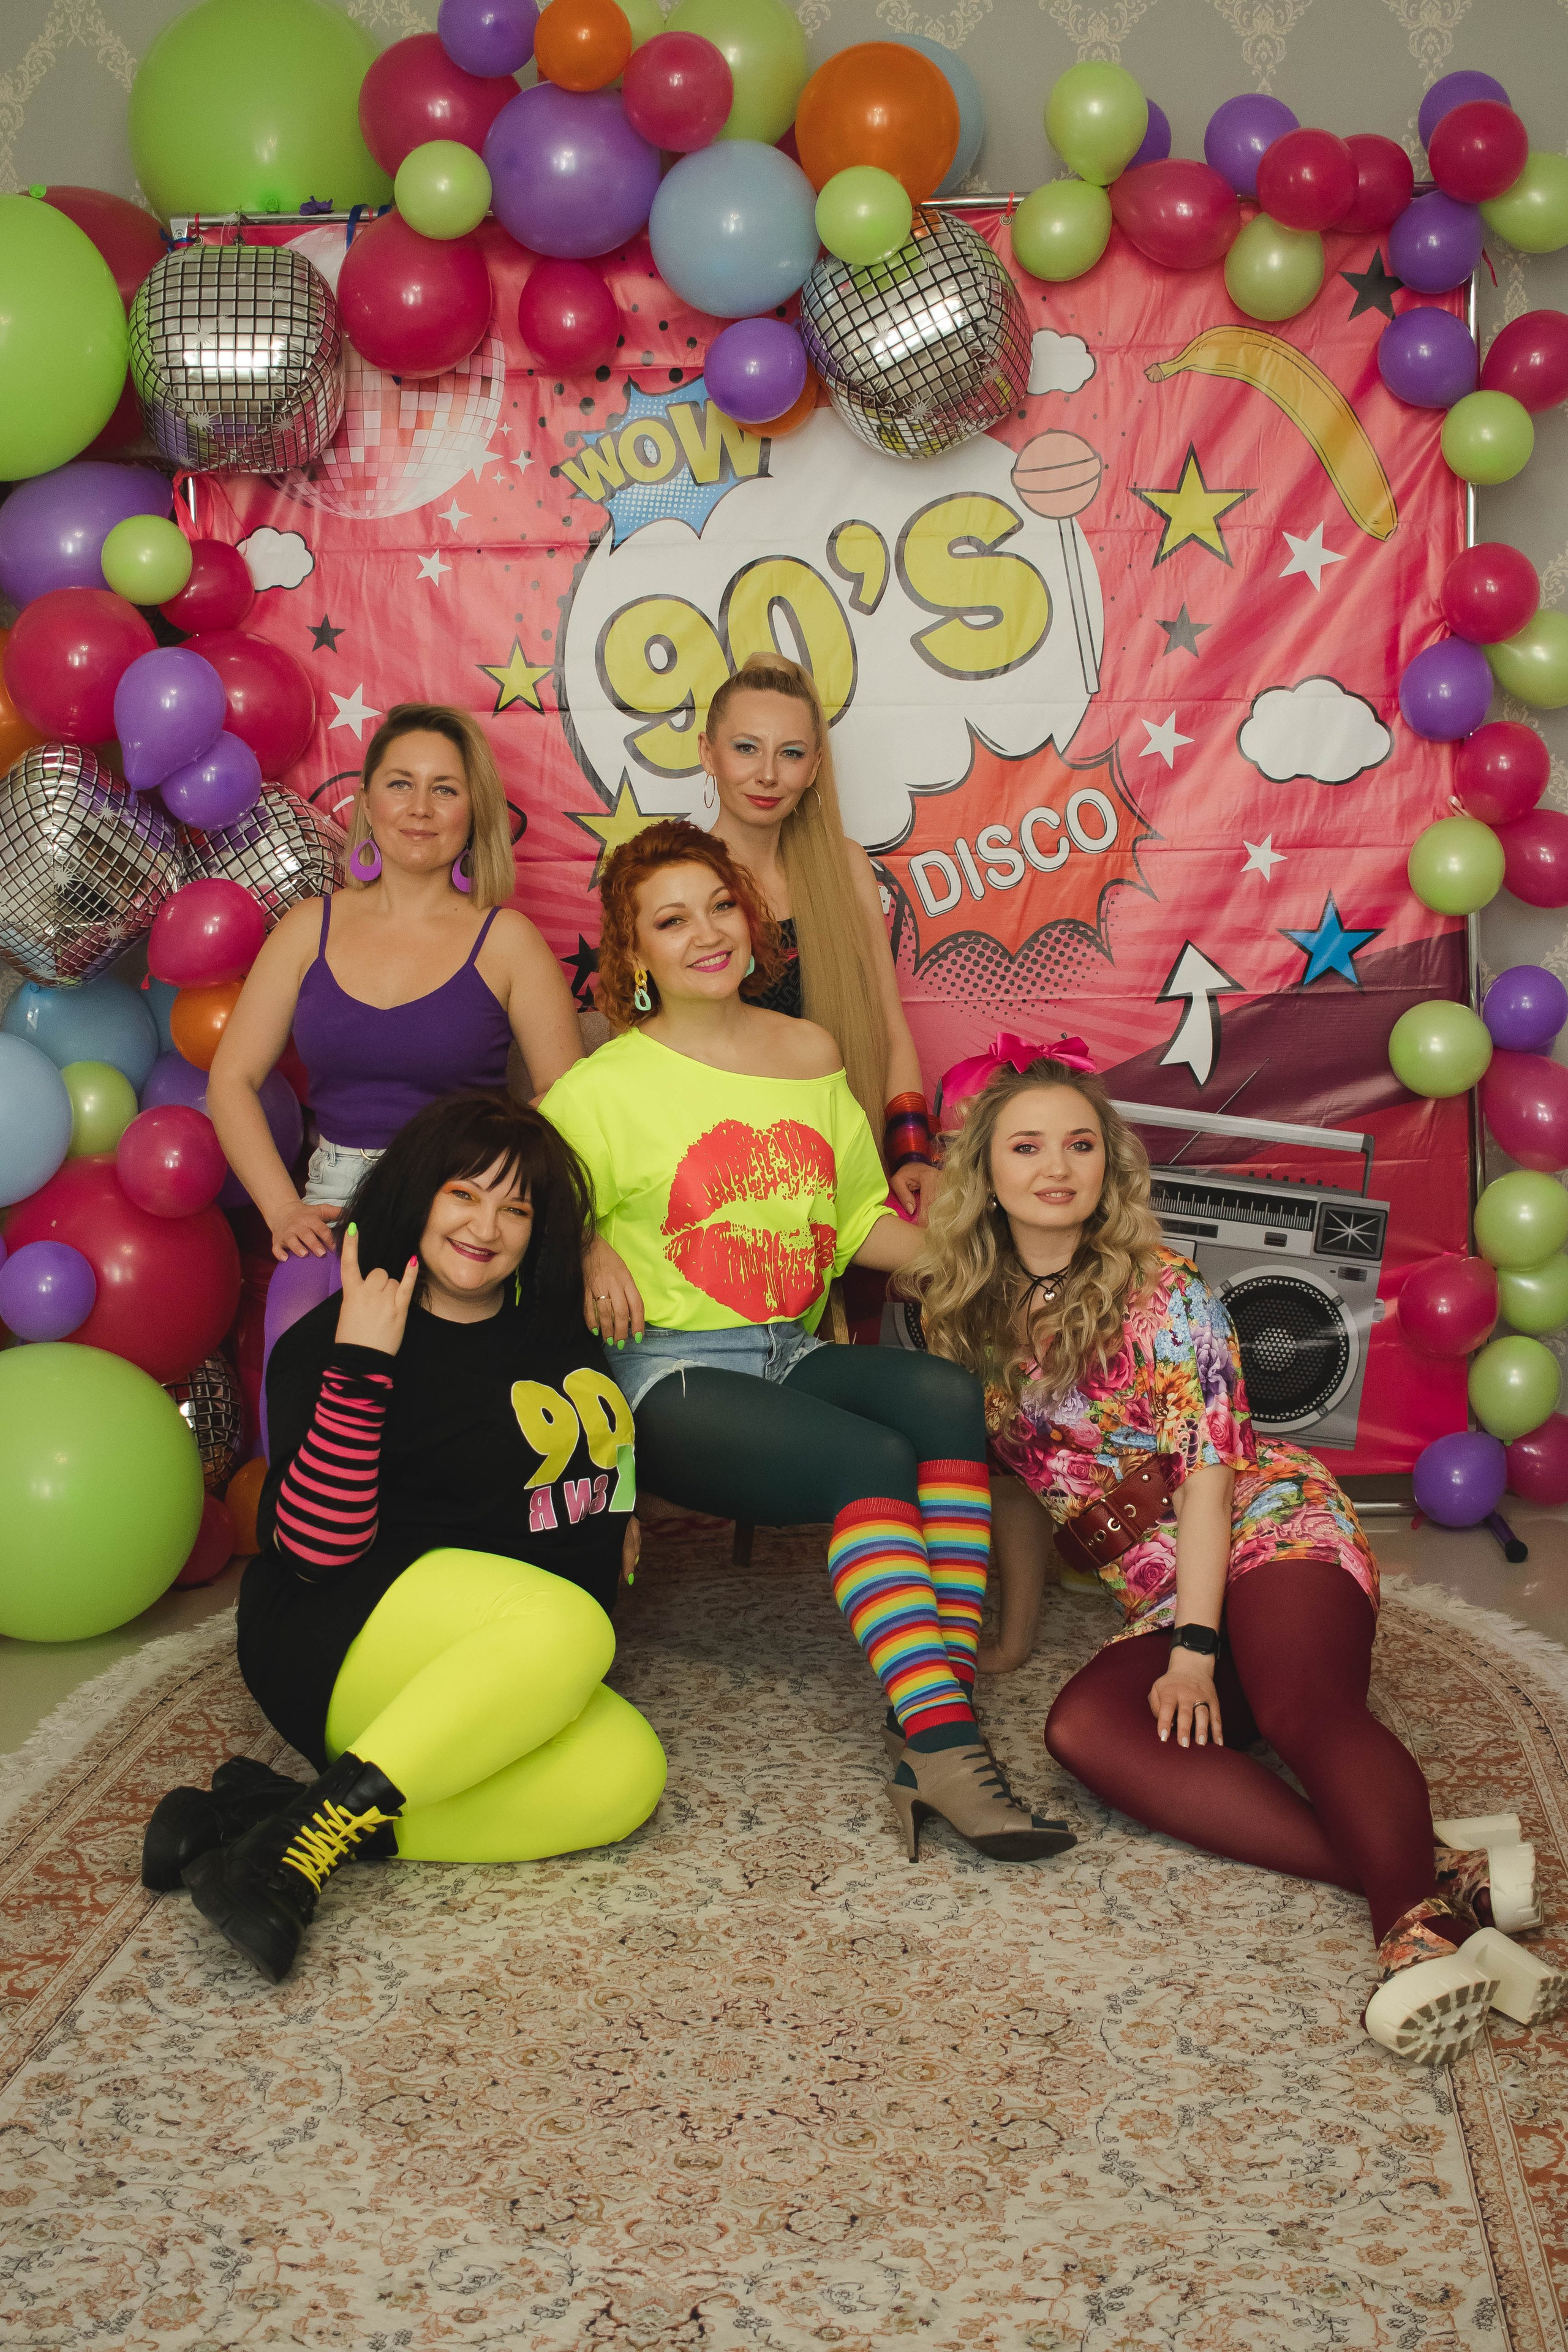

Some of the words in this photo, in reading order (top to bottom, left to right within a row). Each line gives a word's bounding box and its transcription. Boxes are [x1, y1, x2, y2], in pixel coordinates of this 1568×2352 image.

[560, 399, 761, 503] WOW
[595, 491, 1053, 777] 90'S
[908, 788, 1118, 918] DISCO
